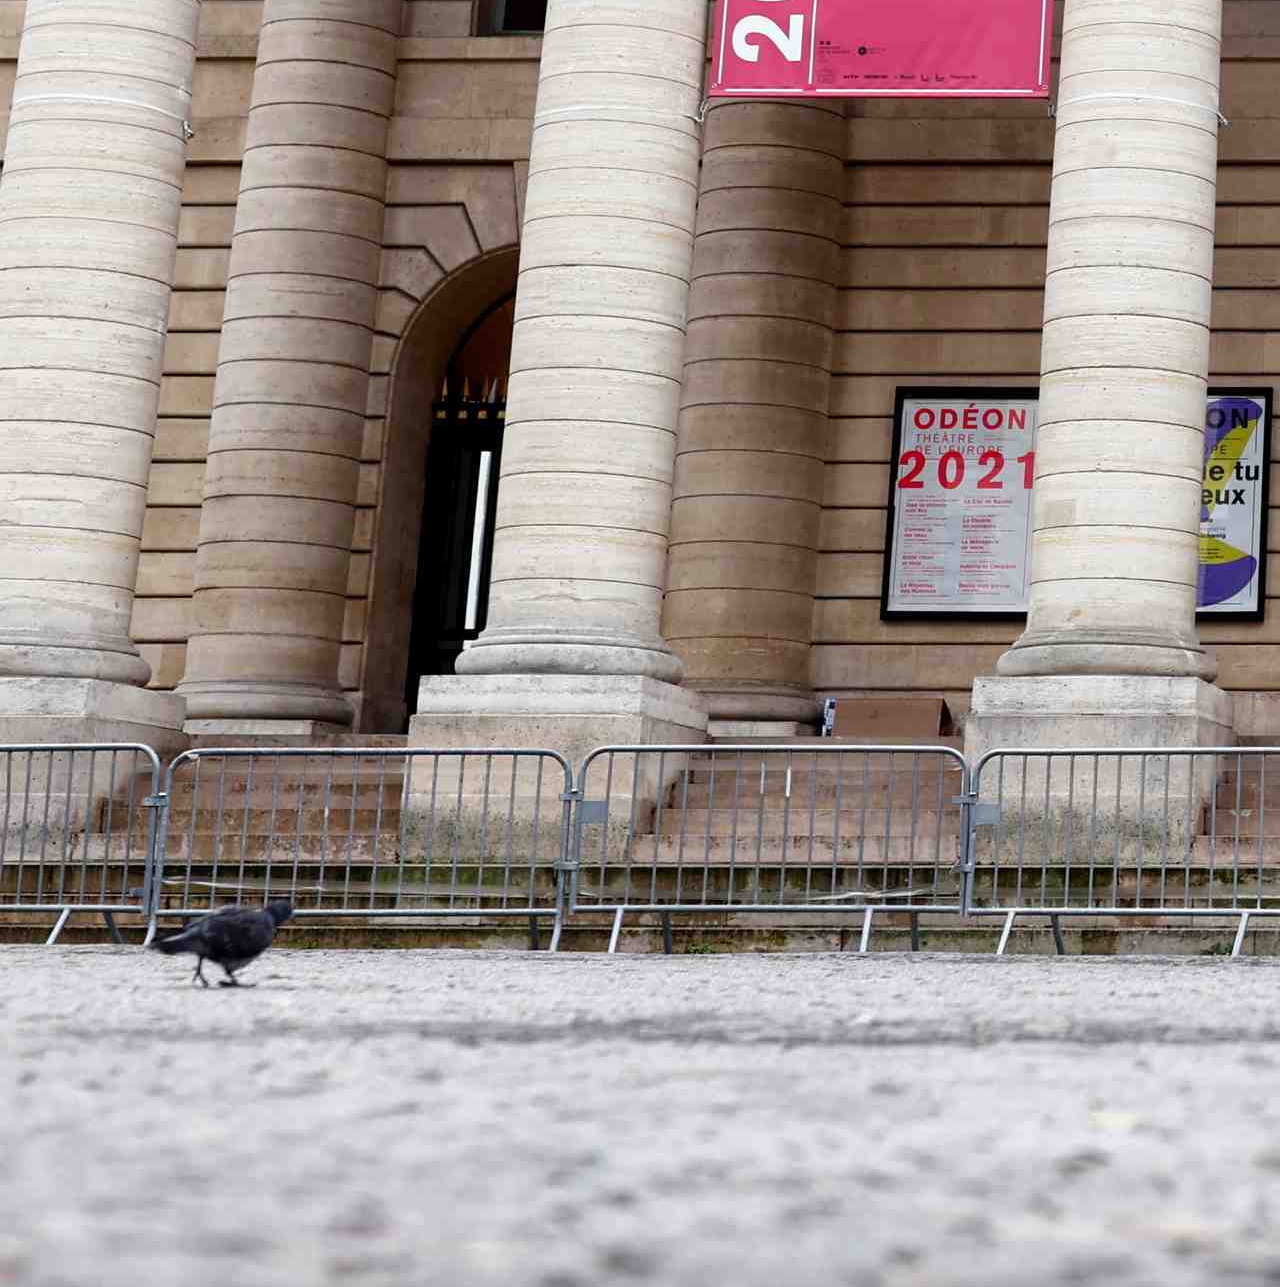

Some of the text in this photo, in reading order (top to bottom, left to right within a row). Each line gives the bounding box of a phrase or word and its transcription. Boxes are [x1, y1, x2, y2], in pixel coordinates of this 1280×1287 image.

[914, 403, 1026, 429] ODÉON
[898, 451, 1036, 489] 2021
[1234, 461, 1259, 480] tu
[1200, 489, 1245, 505] eux
